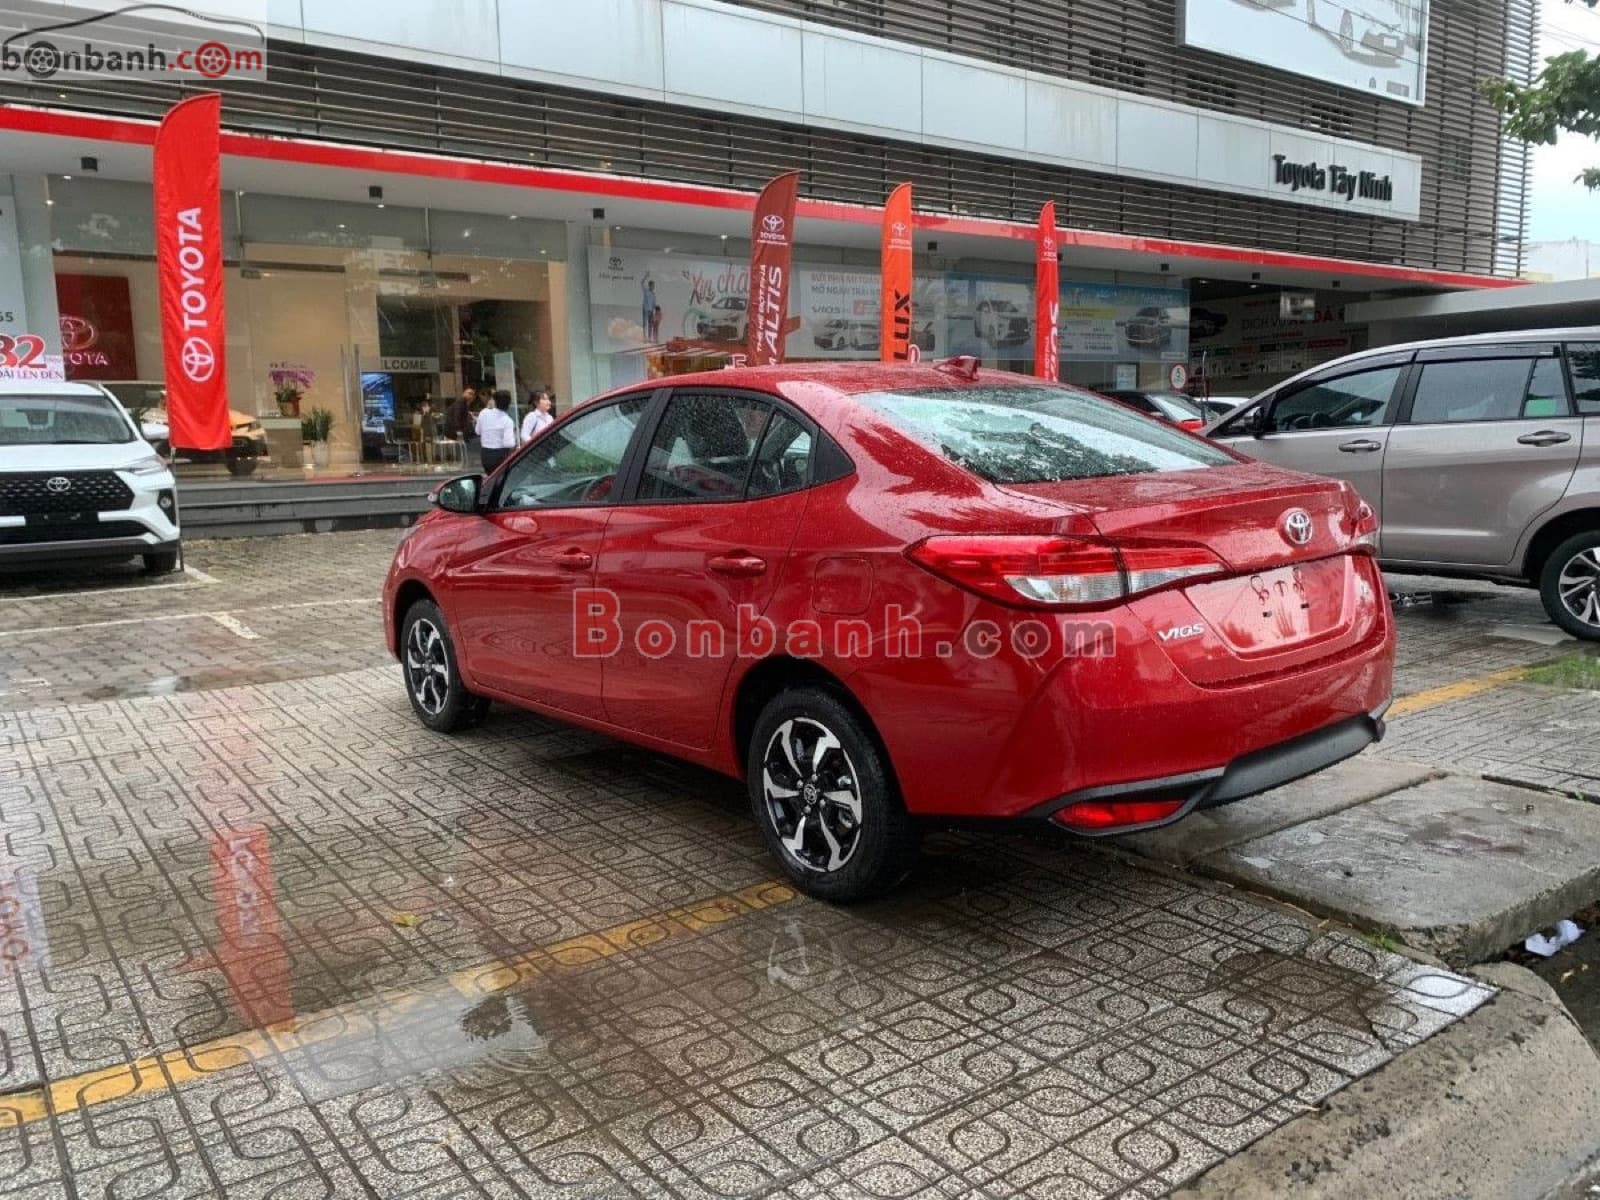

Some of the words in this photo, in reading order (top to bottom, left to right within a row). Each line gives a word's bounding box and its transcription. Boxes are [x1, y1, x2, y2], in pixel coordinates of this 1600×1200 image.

[1272, 153, 1326, 191] Toyota
[1358, 170, 1393, 201] Ninh
[177, 207, 208, 332] TOYOTA
[765, 265, 782, 354] ALTIS
[894, 289, 910, 360] LUX
[69, 352, 109, 366] OTA
[384, 359, 428, 370] LCOME
[1158, 622, 1205, 642] VIOS
